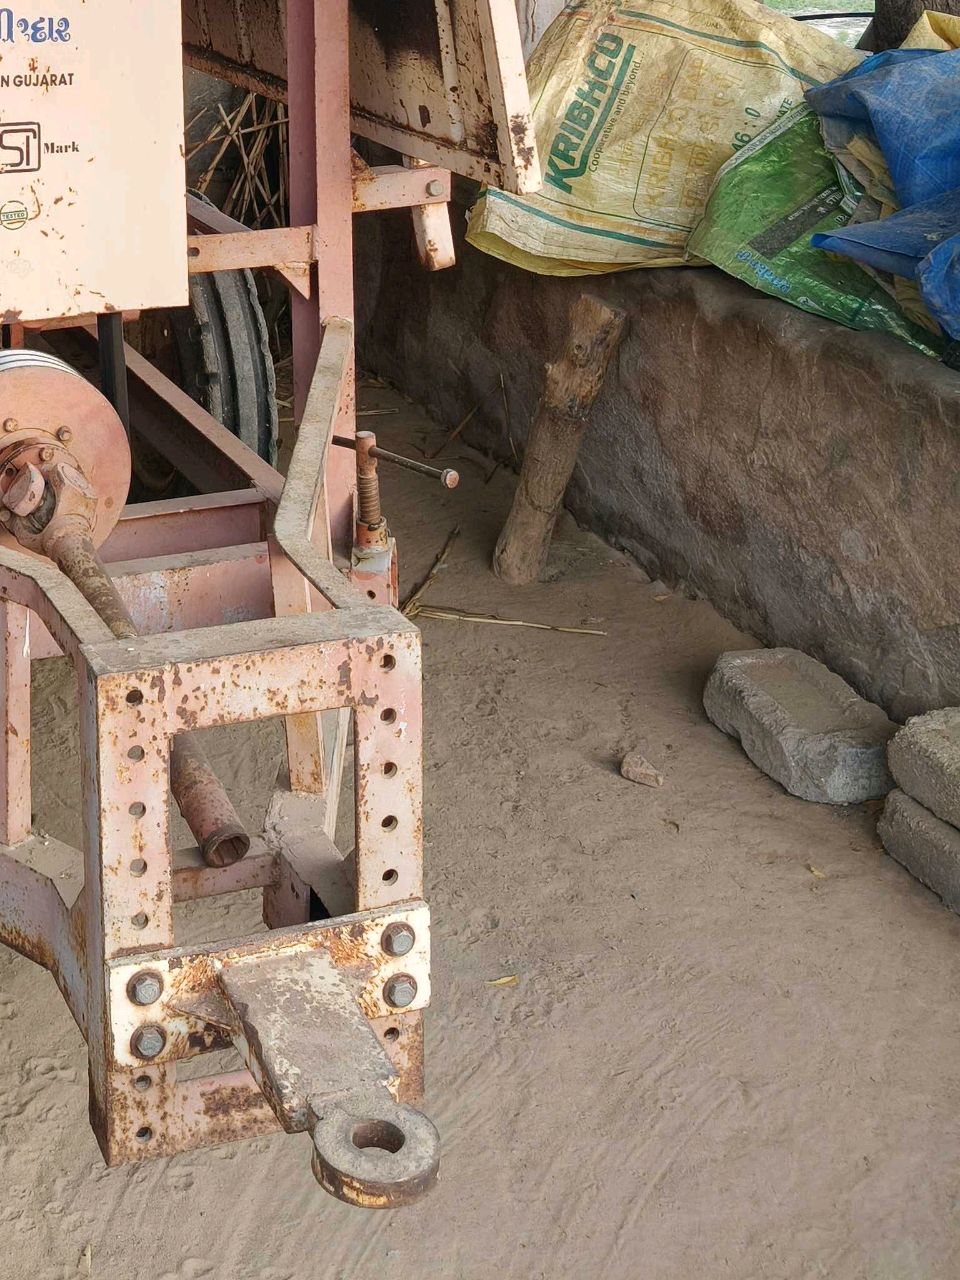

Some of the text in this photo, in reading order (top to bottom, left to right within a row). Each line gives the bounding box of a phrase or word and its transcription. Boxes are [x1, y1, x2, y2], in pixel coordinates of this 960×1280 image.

[13, 73, 74, 87] GUJARAT
[544, 32, 626, 194] KRIBHCO
[589, 116, 617, 173] Cooperative
[613, 93, 627, 116] and
[44, 141, 80, 154] Mark
[2, 211, 25, 220] TESTED
